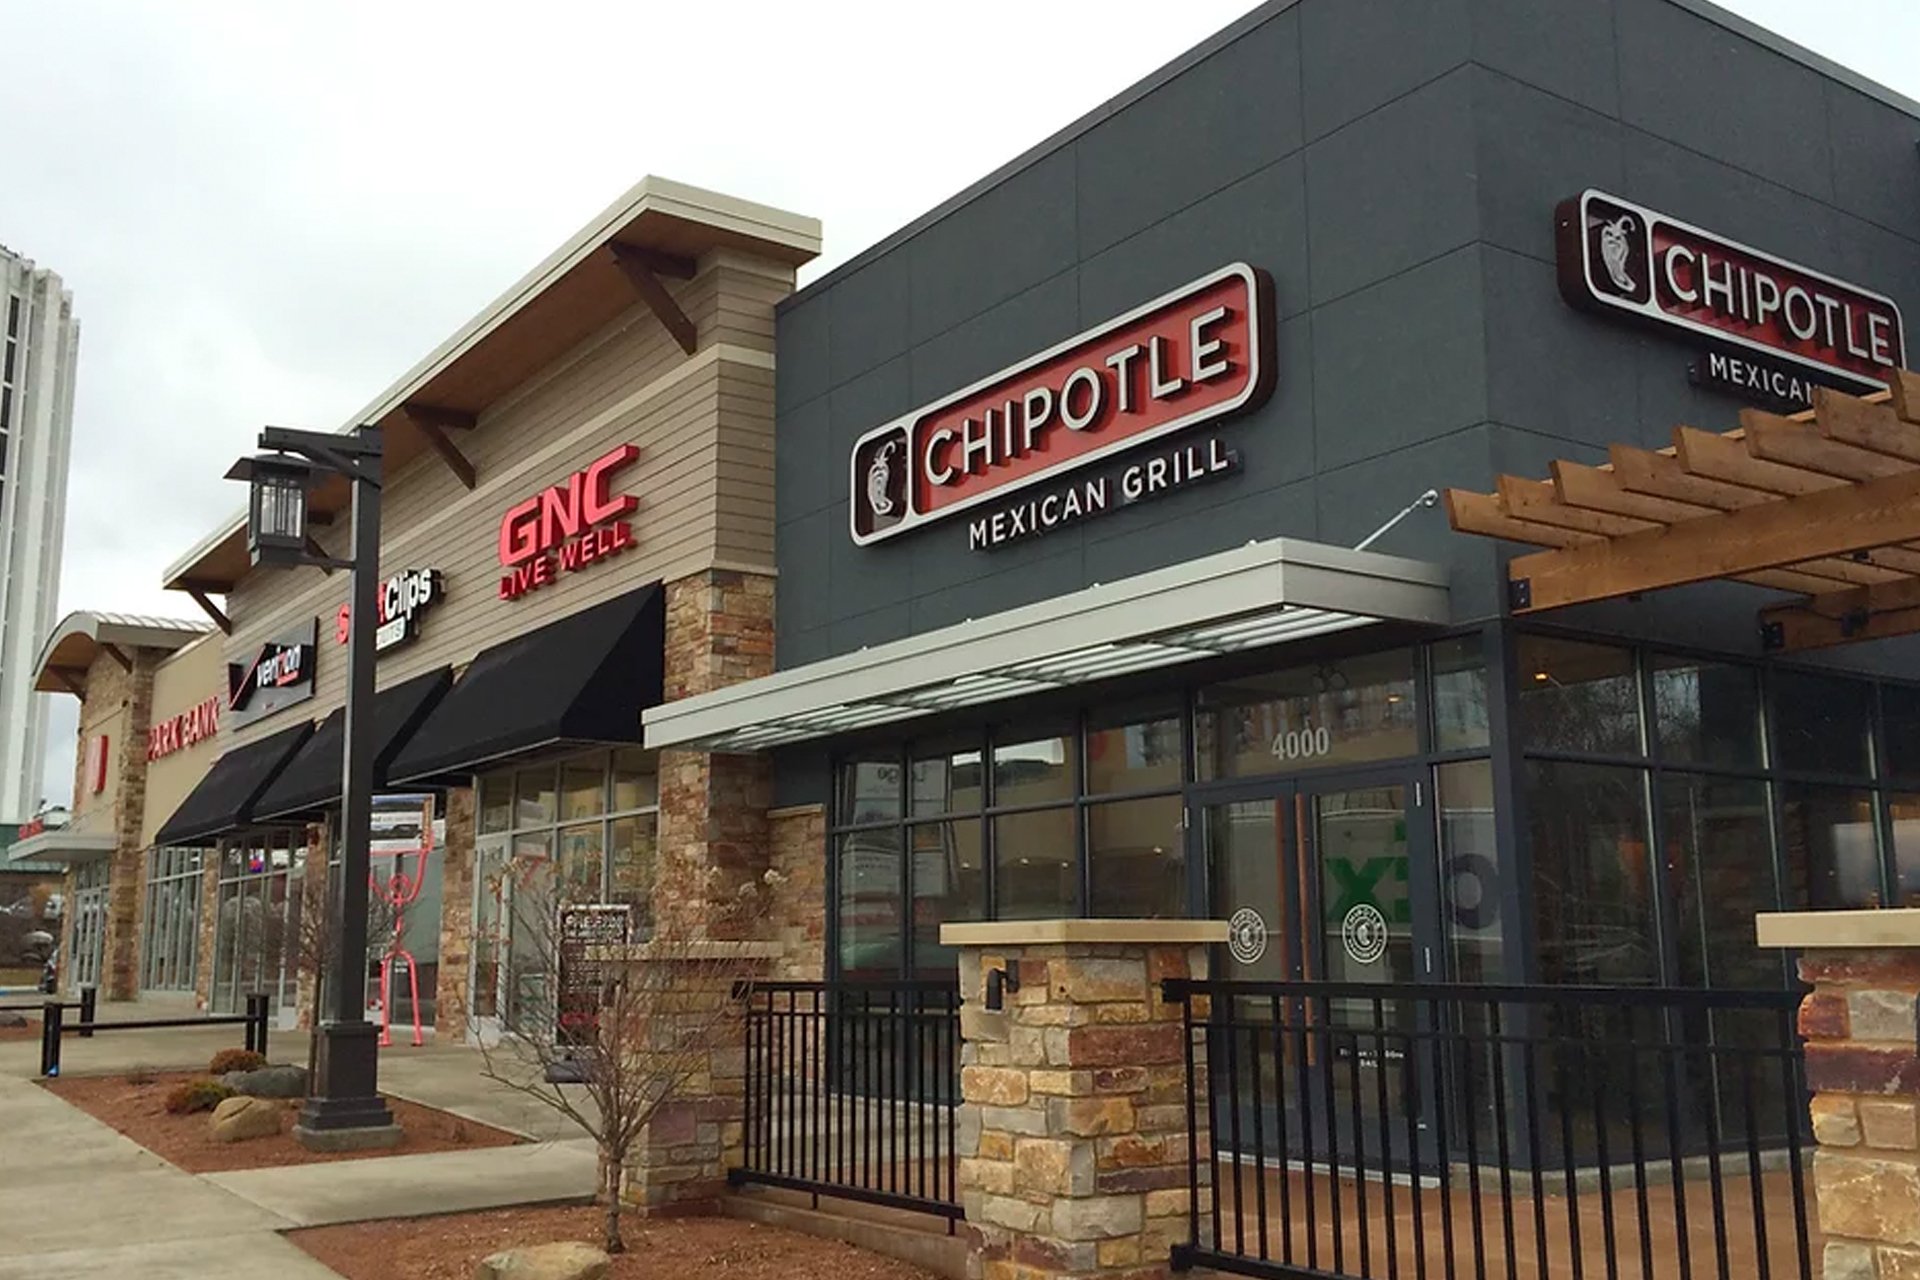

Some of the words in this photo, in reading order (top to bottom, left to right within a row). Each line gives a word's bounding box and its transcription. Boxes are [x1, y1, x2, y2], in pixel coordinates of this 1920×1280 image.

[1664, 245, 1894, 367] CHIPOTLE
[923, 305, 1232, 486] CHIPOTLE
[499, 443, 638, 567] GNC
[969, 477, 1106, 550] MEXICAN
[1121, 439, 1229, 499] GRILL
[385, 569, 431, 621] Clips
[499, 559, 553, 600] LIVE
[557, 521, 634, 573] WELL
[257, 644, 302, 688] verizon
[182, 696, 220, 745] BANK
[1271, 726, 1330, 761] 4000
